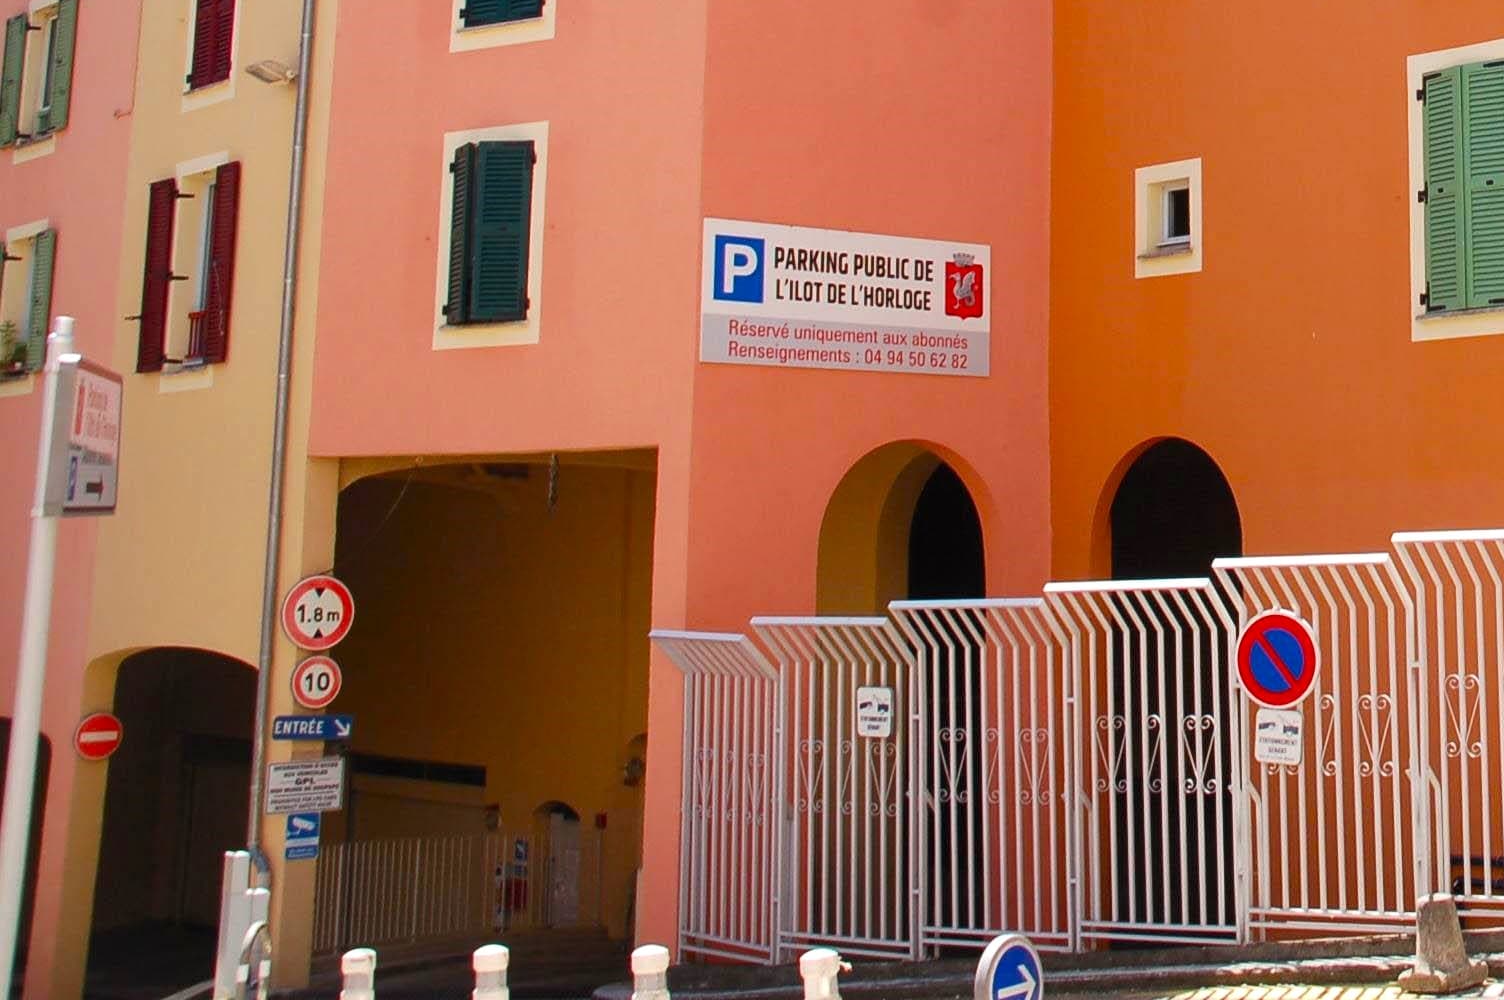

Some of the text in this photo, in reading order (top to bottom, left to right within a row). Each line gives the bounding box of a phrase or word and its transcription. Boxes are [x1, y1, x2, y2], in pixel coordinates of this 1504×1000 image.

[723, 243, 758, 294] P
[774, 246, 934, 282] PARKING PUBLIC DE
[776, 278, 931, 311] L'ILOT DE L'HORLOGE
[729, 319, 968, 350] Réservé uniquement aux abonnés
[728, 341, 850, 363] Renseignements
[864, 349, 881, 365] 04
[886, 350, 903, 366] 94
[909, 351, 926, 367] 50
[930, 352, 947, 368] 62
[951, 353, 968, 369] 82
[297, 604, 340, 623] 1.8 m
[305, 672, 330, 692] 10
[274, 718, 324, 734] ENTRÉE
